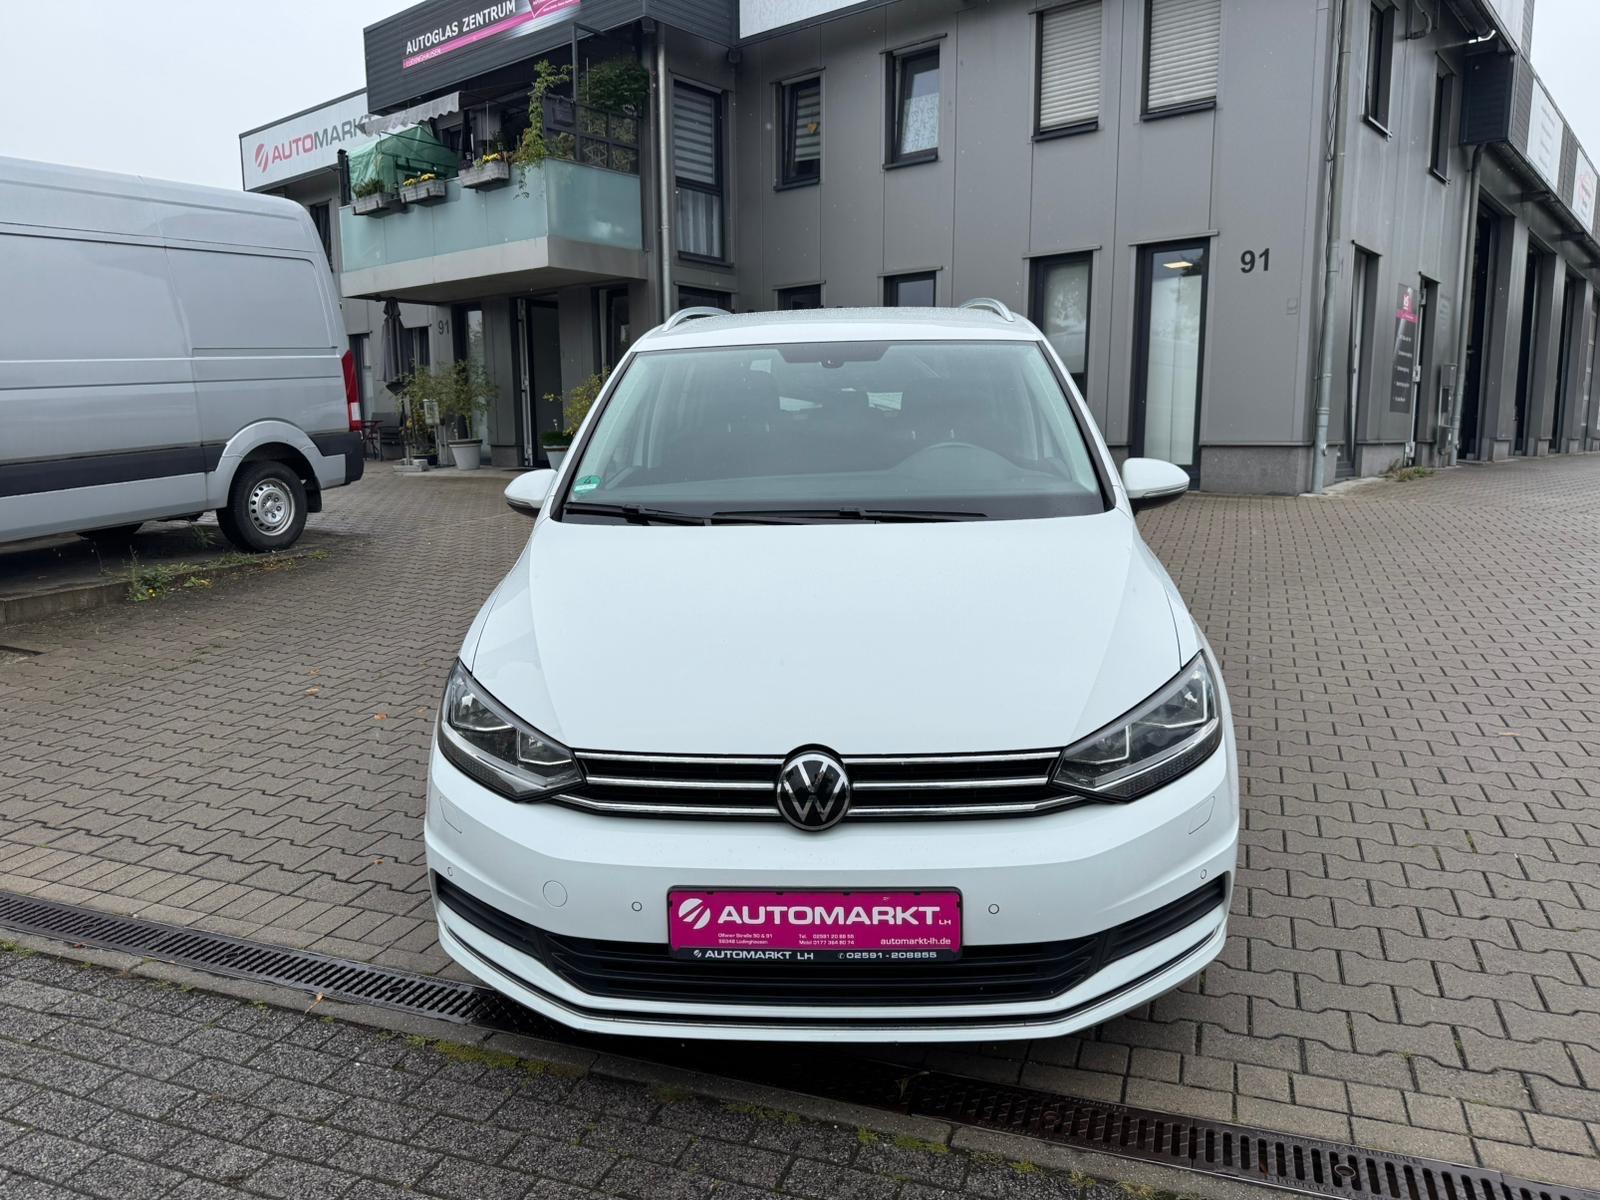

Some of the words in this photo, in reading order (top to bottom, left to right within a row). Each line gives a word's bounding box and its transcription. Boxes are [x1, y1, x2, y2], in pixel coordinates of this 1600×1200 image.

[406, 21, 459, 55] AUTOGLAS
[462, 0, 516, 32] ZENTRUM
[1240, 247, 1270, 273] 91
[438, 318, 450, 335] 91
[717, 906, 940, 925] AUTOMARKT
[880, 937, 951, 945] automarkt-lh.de
[705, 950, 792, 960] AUTOMARKT
[797, 952, 814, 960] LH
